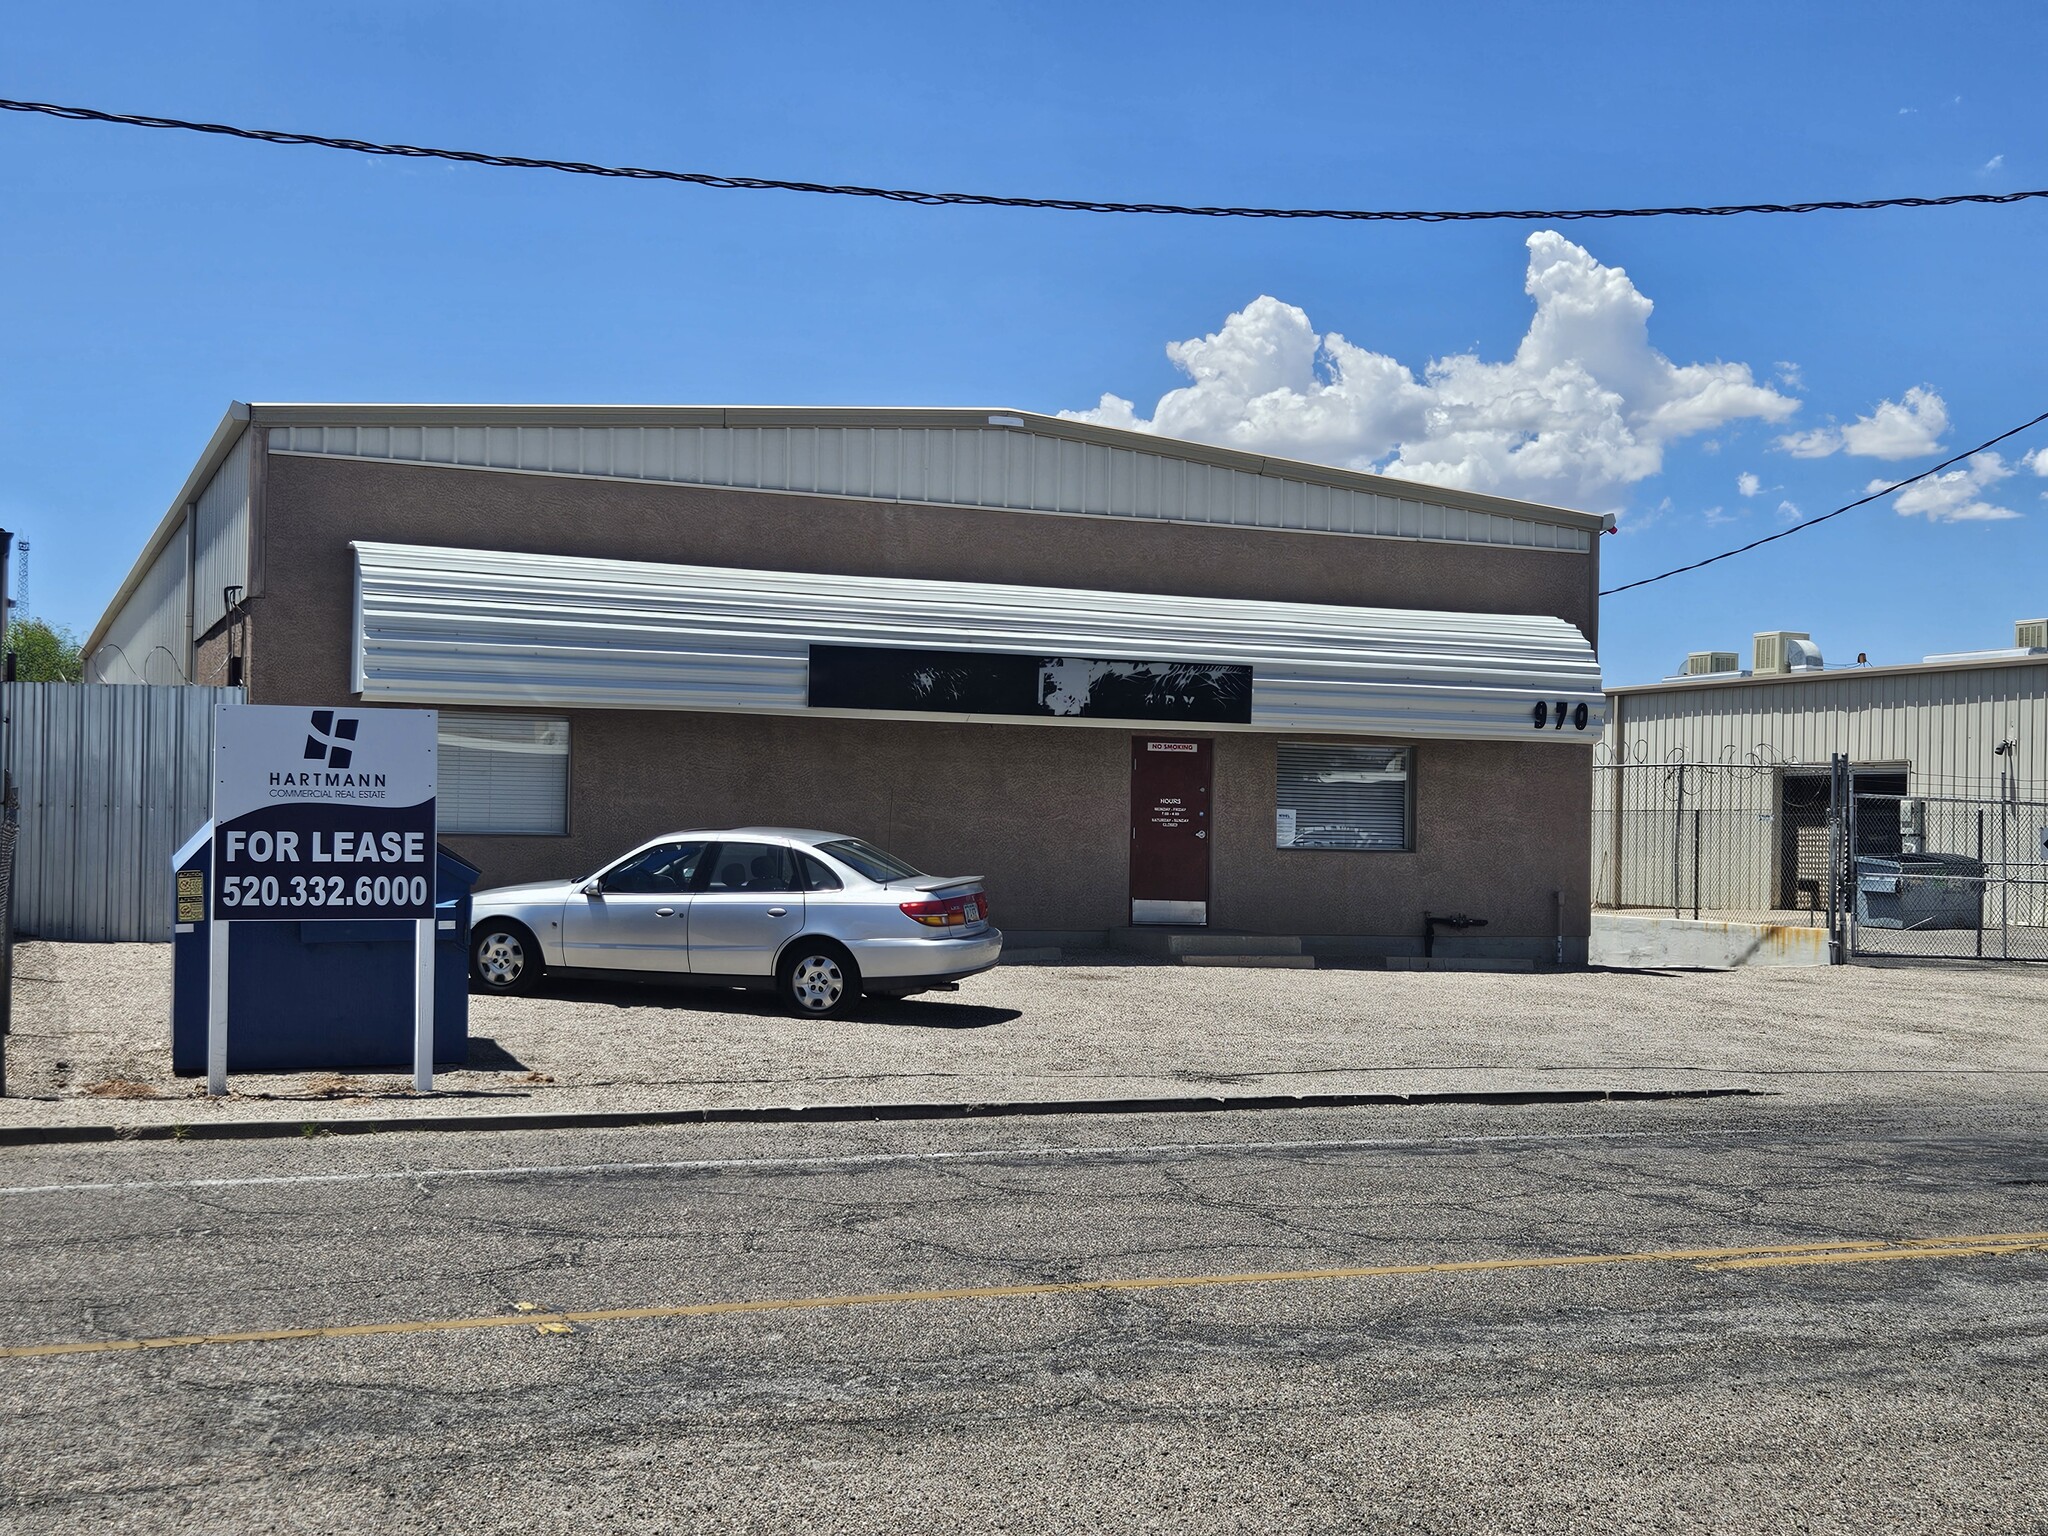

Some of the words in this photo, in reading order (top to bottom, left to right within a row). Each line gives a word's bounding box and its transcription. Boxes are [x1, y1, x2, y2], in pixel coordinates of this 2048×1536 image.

[1534, 701, 1588, 730] 970
[269, 772, 386, 787] HARTMANN
[269, 789, 332, 798] COMMERCIAL
[335, 790, 356, 798] REAL
[359, 791, 385, 799] ESTATE
[226, 831, 299, 862] FOR
[312, 831, 424, 863] LEASE
[222, 876, 428, 906] 520.332.6000
